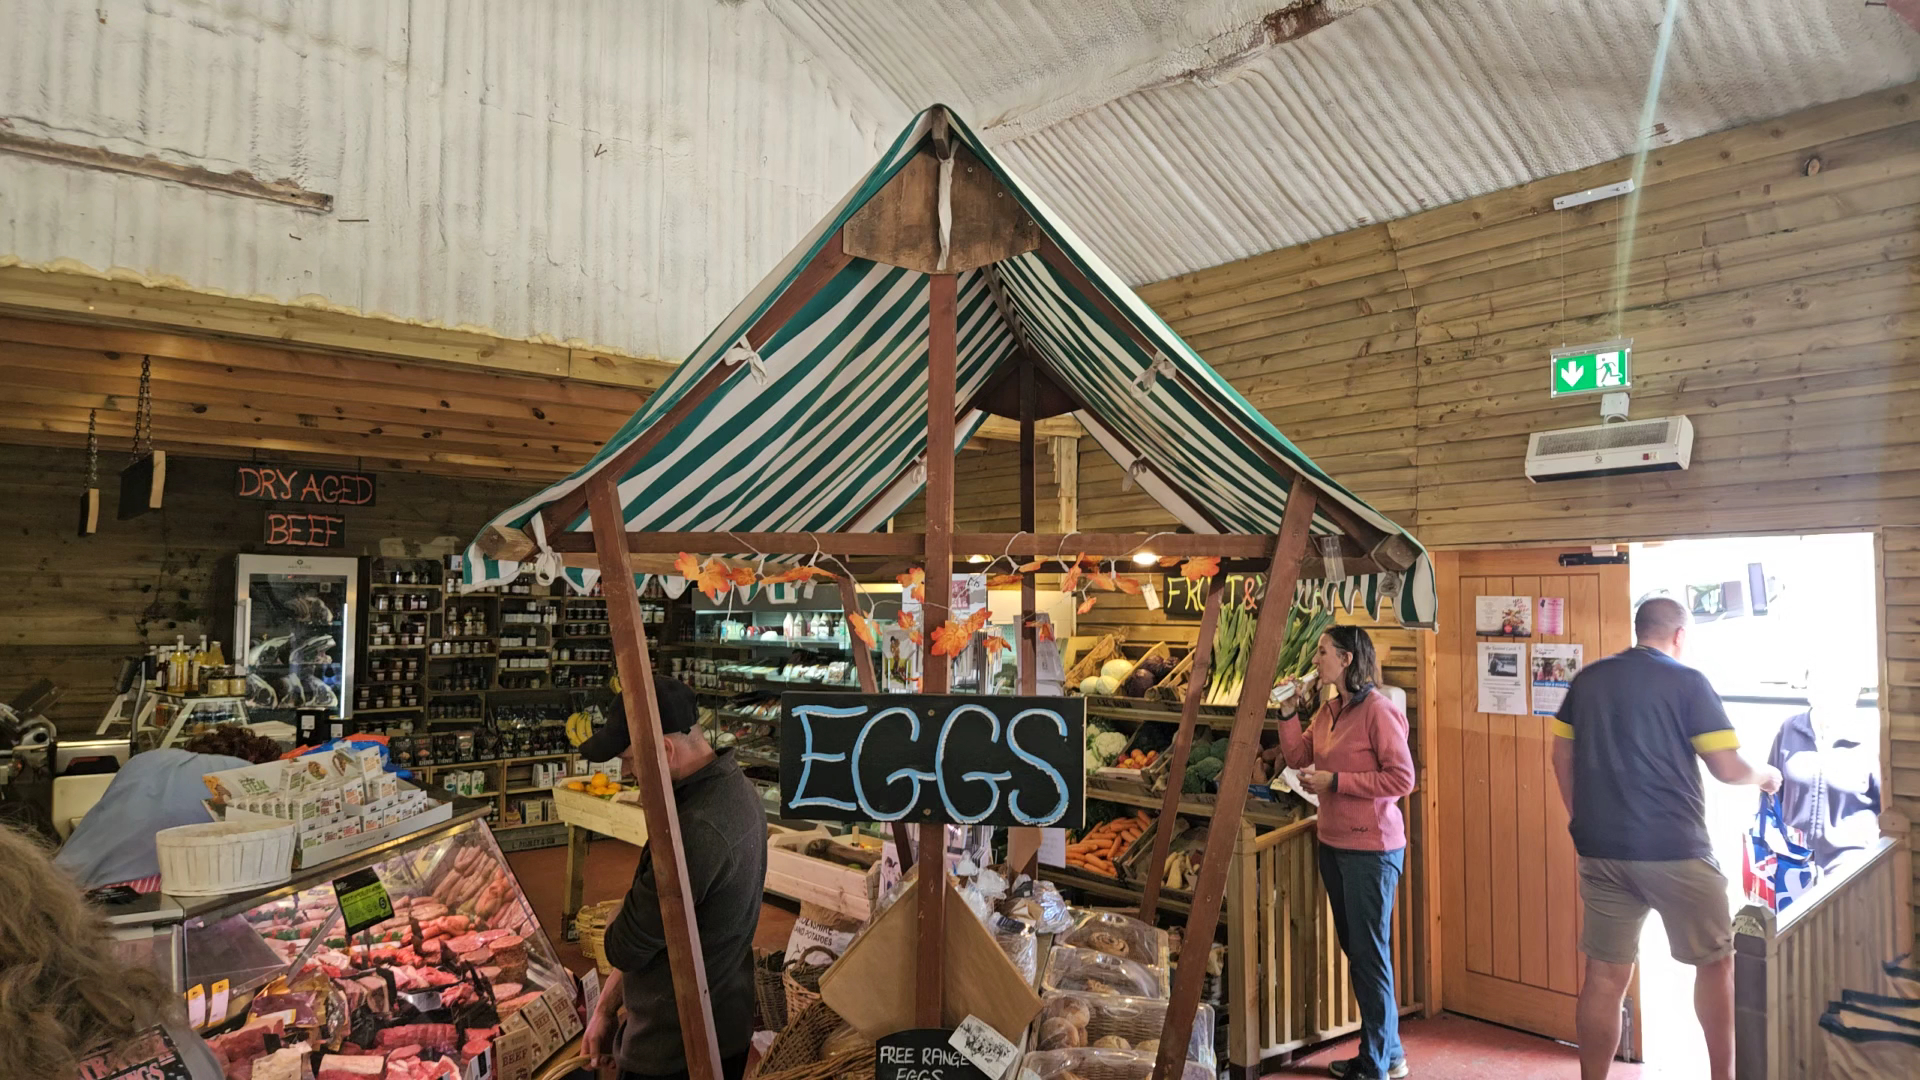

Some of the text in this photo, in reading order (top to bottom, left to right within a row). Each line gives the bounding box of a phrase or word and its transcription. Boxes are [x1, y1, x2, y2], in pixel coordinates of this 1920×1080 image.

[239, 467, 373, 505] DRY AGED
[266, 513, 343, 547] BEEF
[1167, 575, 1244, 611] FRUT
[788, 703, 1070, 828] EGGS
[503, 1049, 528, 1068] BEEF
[880, 1045, 971, 1069] FREE RANGE
[895, 1067, 945, 1080] EGGS
